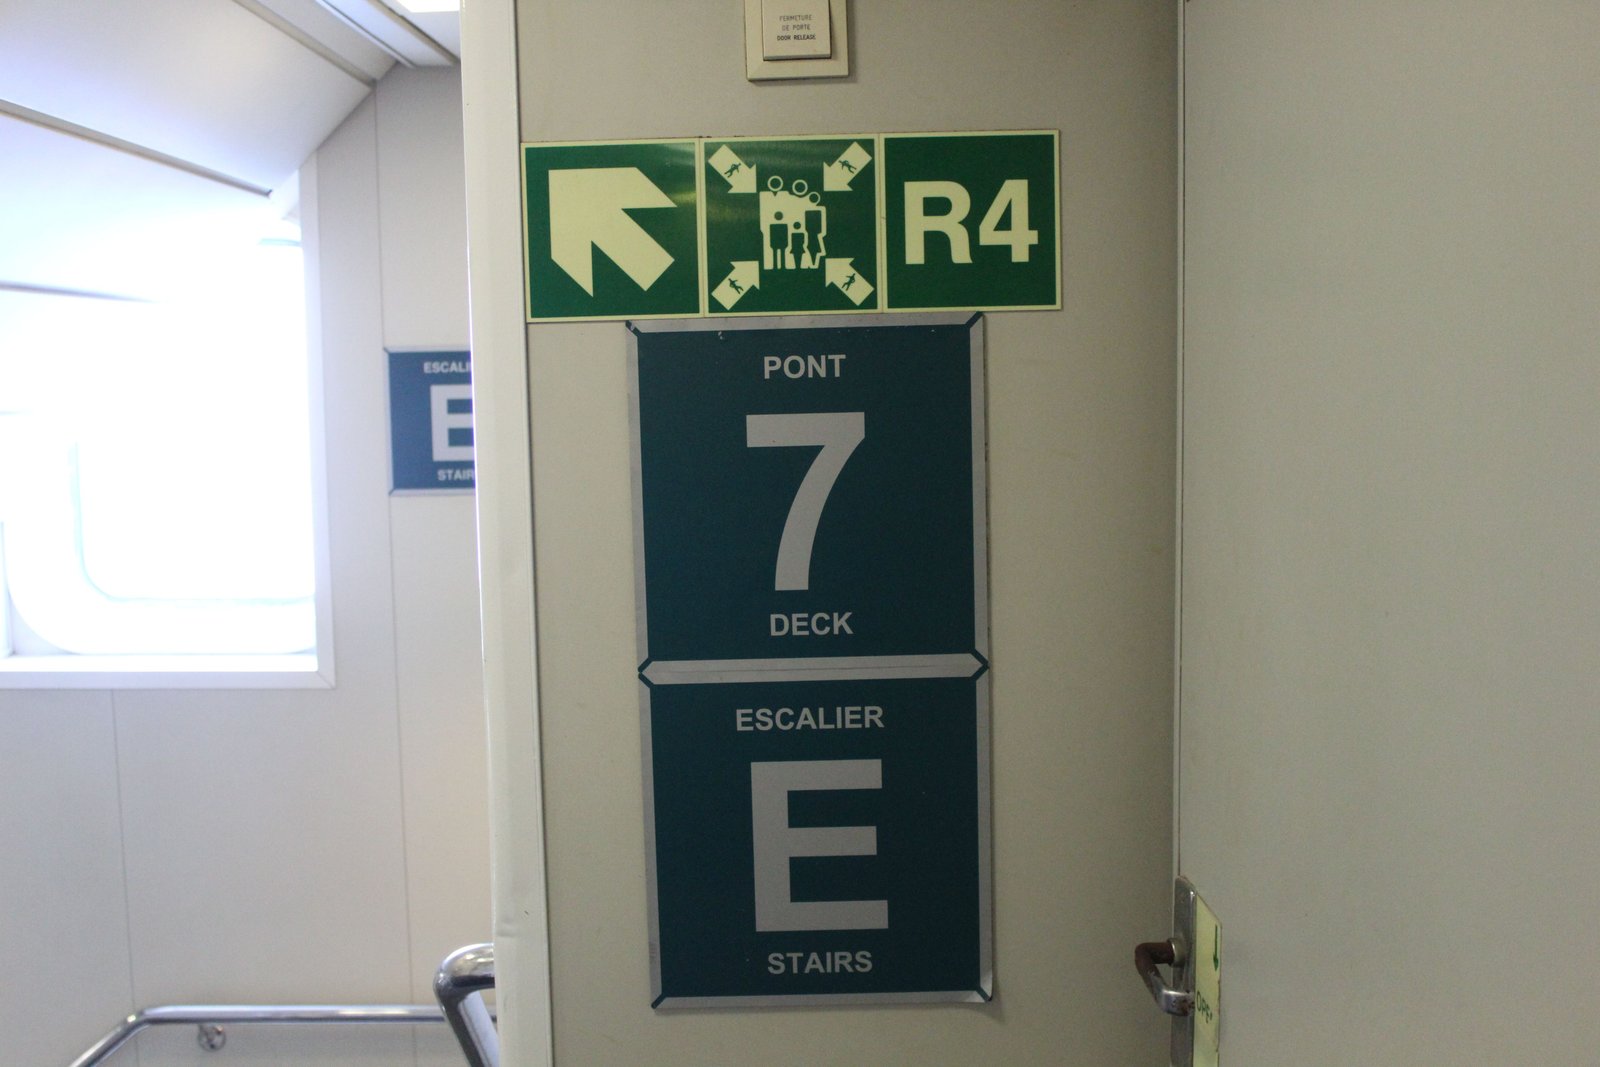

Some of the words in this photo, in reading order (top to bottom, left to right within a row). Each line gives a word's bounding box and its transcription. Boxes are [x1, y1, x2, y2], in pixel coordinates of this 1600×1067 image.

[904, 179, 1039, 265] R4
[763, 354, 846, 380] PONT
[430, 384, 475, 462] E
[746, 412, 865, 591] 7
[769, 612, 854, 637] DECK
[736, 705, 885, 731] ESCALIER
[751, 758, 889, 932] E
[767, 950, 873, 974] STAIRS
